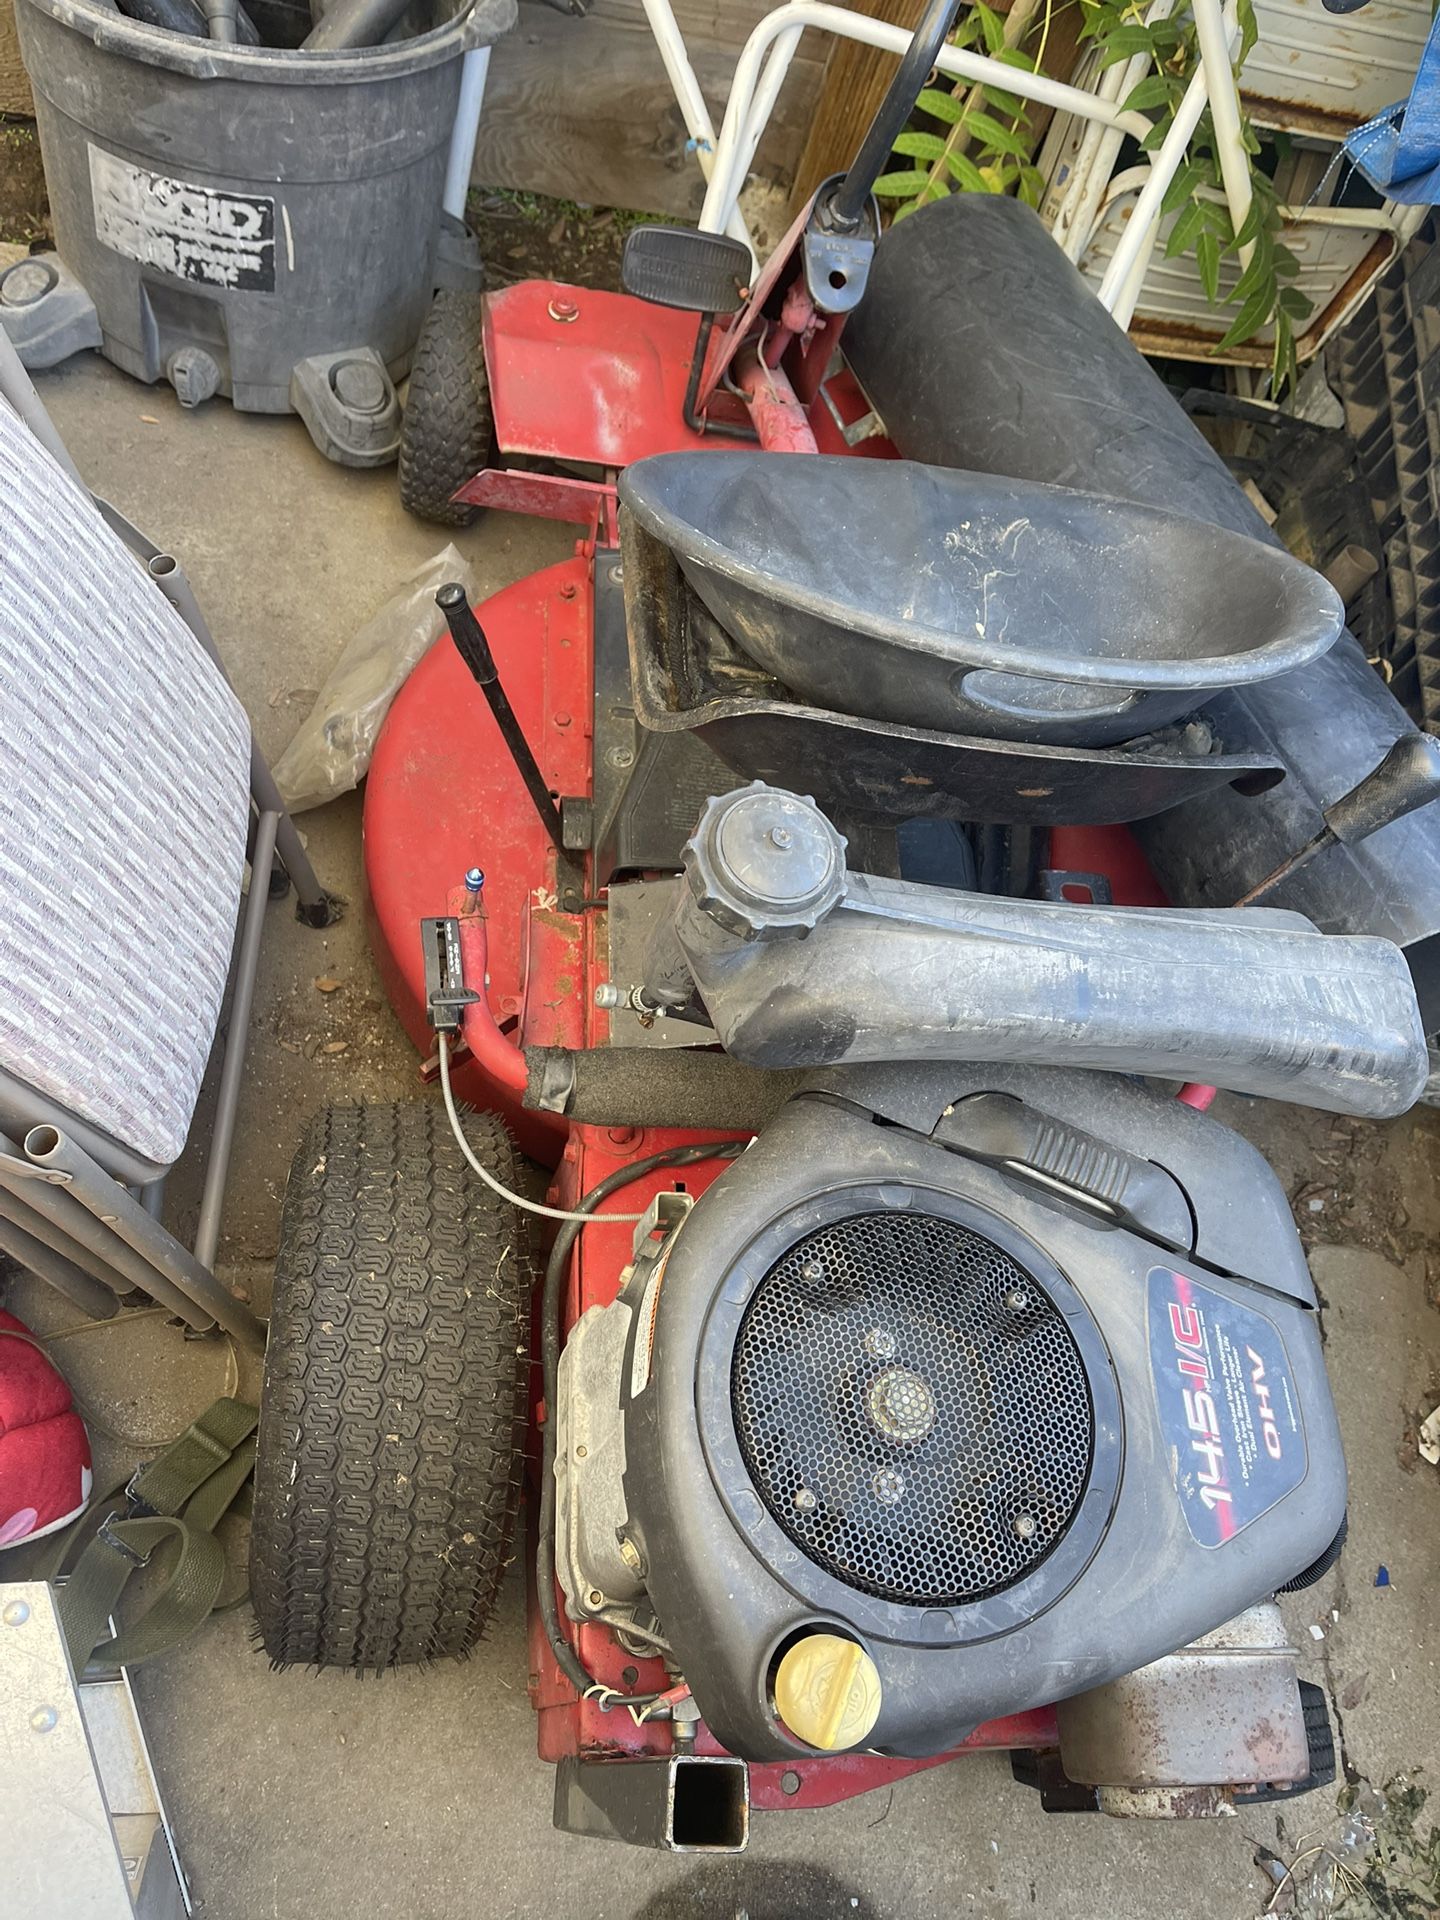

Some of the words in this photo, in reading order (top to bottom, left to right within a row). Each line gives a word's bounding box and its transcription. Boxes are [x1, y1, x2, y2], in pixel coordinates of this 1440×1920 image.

[1215, 1323, 1229, 1377] Performance
[1223, 1336, 1231, 1352] Life
[1227, 1353, 1237, 1383] Longer
[1232, 1346, 1243, 1379] Cleaner
[1225, 1377, 1234, 1401] Valve
[1234, 1390, 1244, 1418] Sleeve
[1246, 1344, 1282, 1460] OHV
[1228, 1402, 1242, 1443] Overhead
[1241, 1394, 1252, 1430] Element
[1240, 1420, 1248, 1438] Iron
[1248, 1431, 1257, 1451] Dual
[1184, 1388, 1233, 1510] 14.5
[1238, 1444, 1249, 1479] Durable
[1243, 1440, 1253, 1462] Cast
